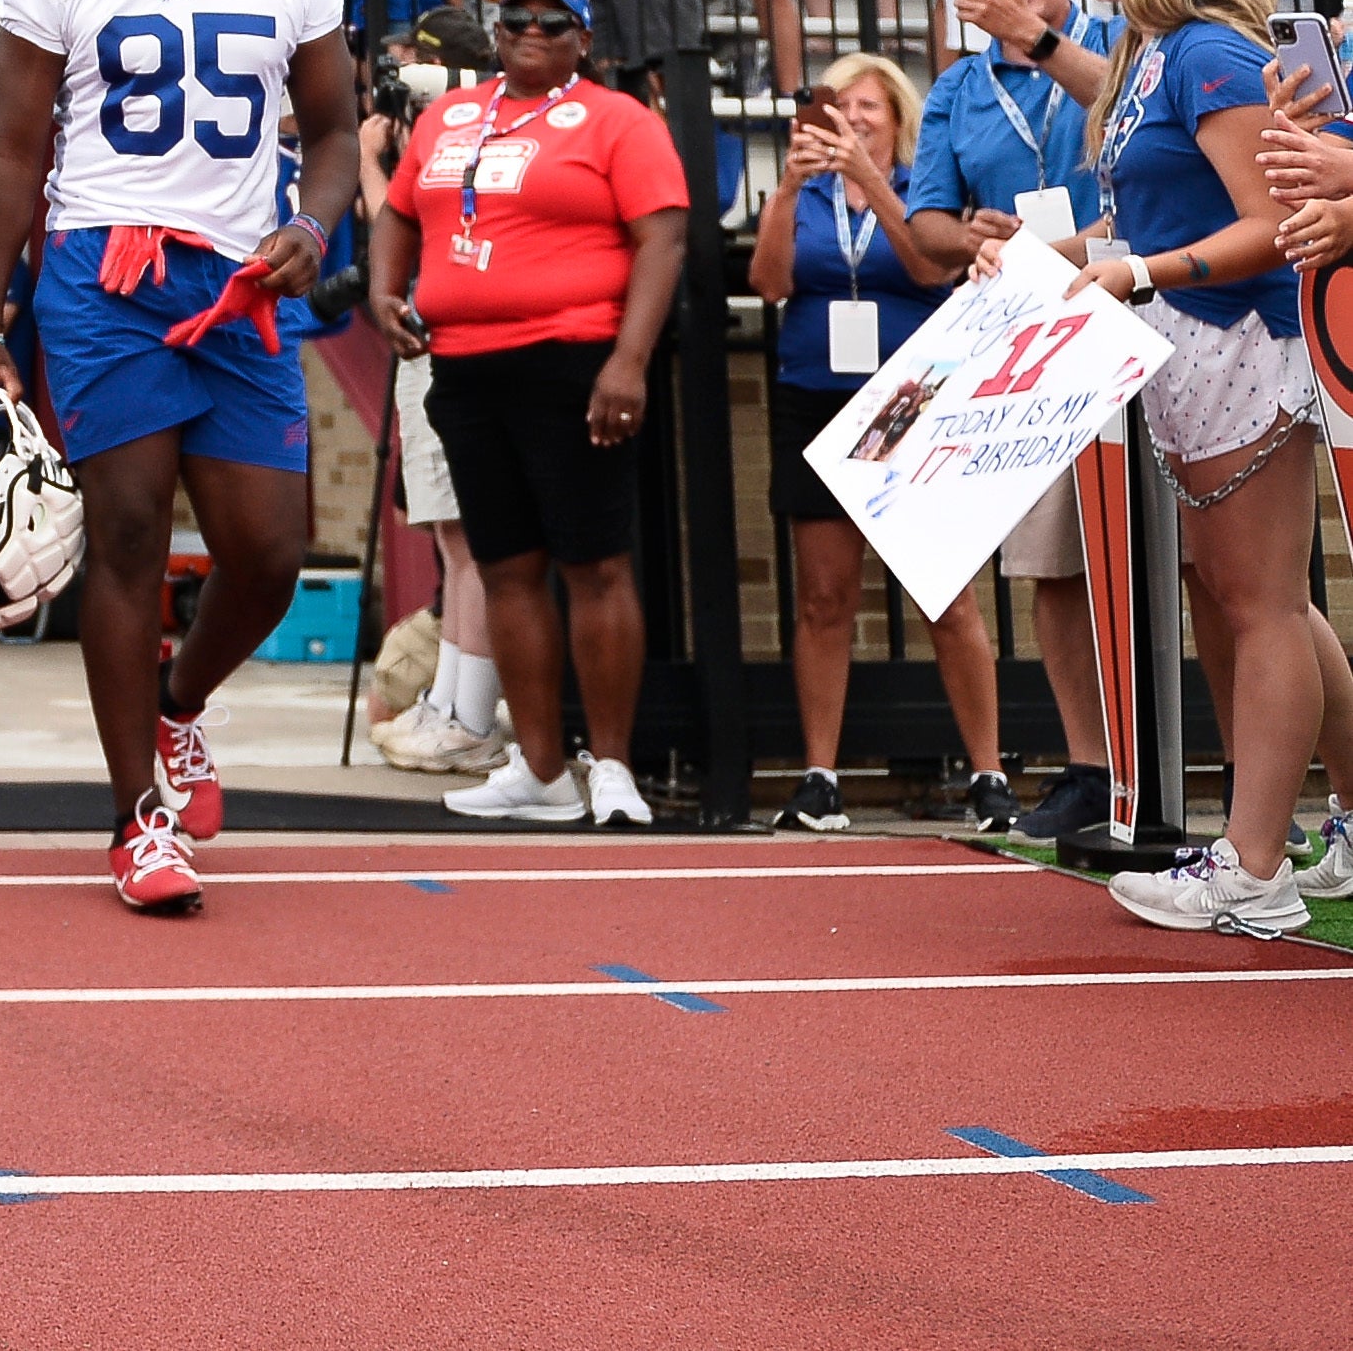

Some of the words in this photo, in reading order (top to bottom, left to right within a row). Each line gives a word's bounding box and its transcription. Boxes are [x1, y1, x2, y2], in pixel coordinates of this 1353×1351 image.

[96, 12, 277, 160] 85
[930, 405, 1011, 441] TODAY
[1018, 397, 1046, 427] IS
[1048, 390, 1099, 426] MY
[961, 428, 1096, 477] BIRTHDAY!
